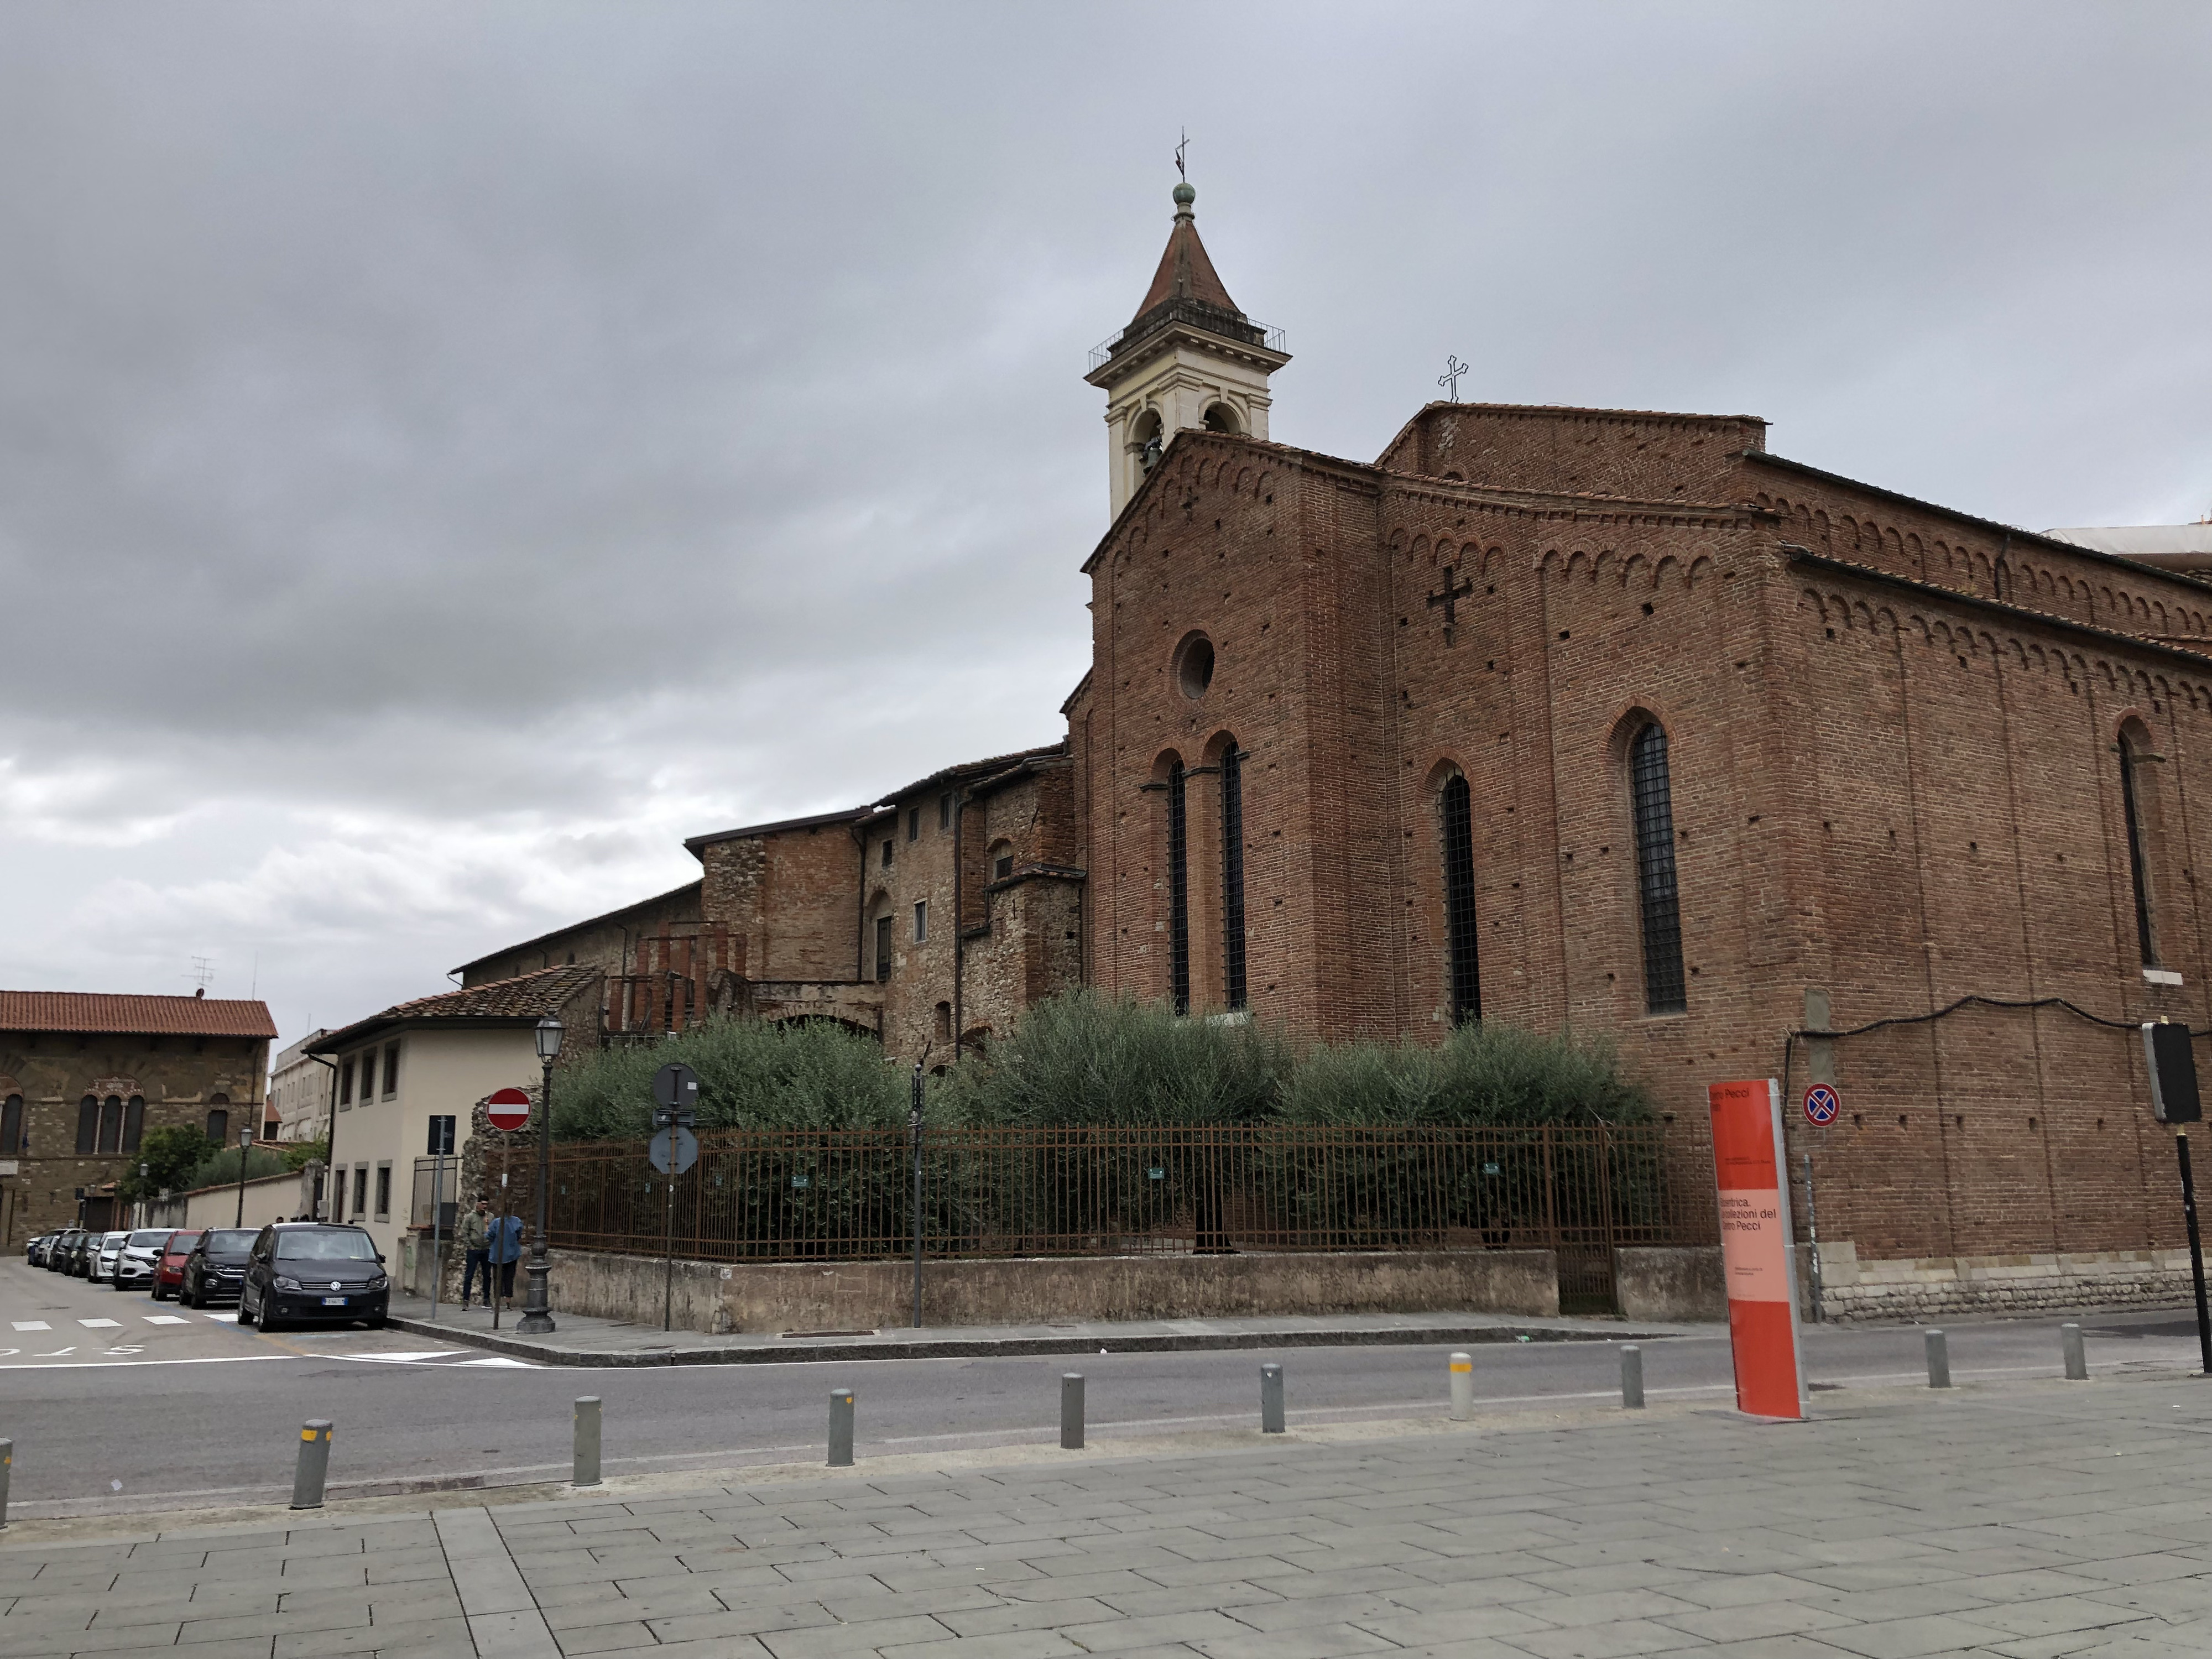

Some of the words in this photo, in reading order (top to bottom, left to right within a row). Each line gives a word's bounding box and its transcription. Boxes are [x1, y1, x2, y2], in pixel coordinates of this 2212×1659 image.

[1725, 1088, 1749, 1099] Pecci
[1760, 1209, 1776, 1218] del
[1736, 1220, 1761, 1230] Pecci
